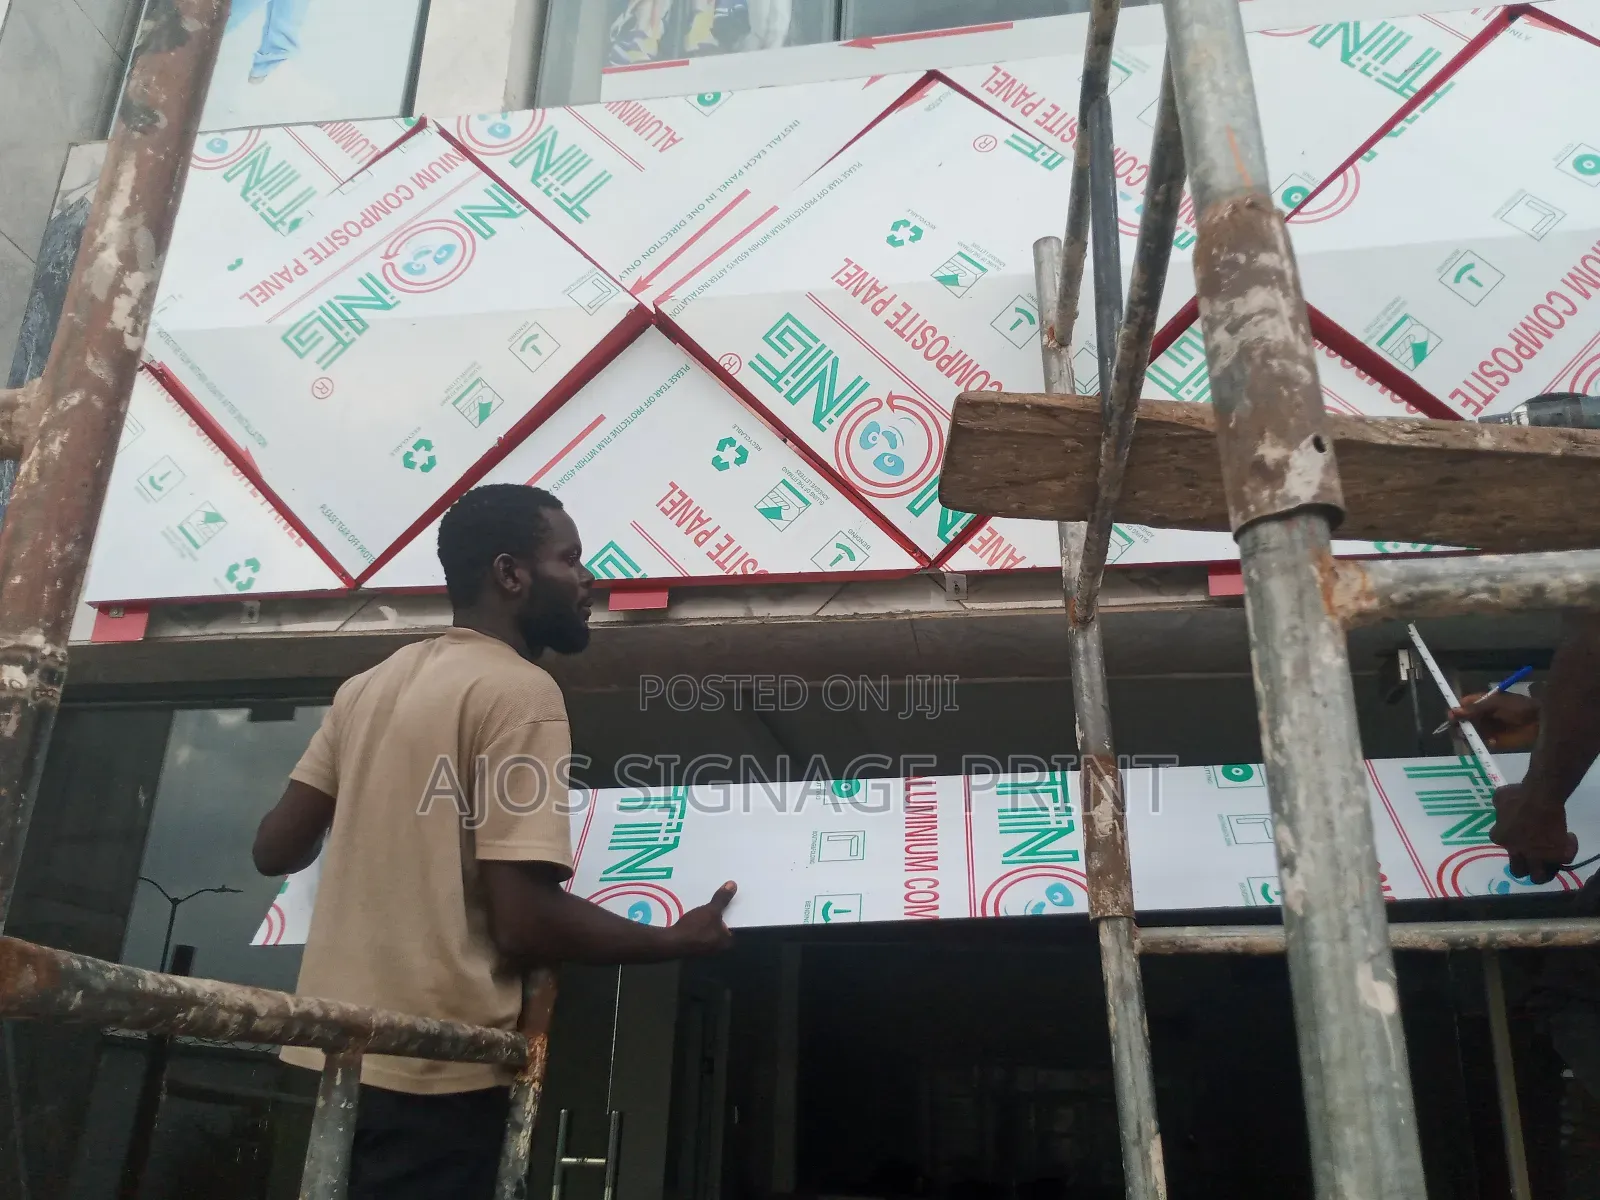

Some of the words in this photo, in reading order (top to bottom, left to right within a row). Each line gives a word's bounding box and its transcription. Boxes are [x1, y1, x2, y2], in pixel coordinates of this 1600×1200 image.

[980, 64, 1046, 117] PANEL
[764, 118, 801, 151] INSTALL
[742, 147, 767, 170] EACH
[715, 168, 744, 195] PANEL
[704, 191, 717, 204] IN
[685, 201, 706, 221] ONE
[303, 184, 415, 266] COMPOSITE
[640, 218, 687, 260] DIRECTION
[239, 258, 309, 308] PANEL
[619, 259, 643, 282] ONLY
[830, 257, 898, 316] PANEL
[1448, 290, 1578, 417] COMPOSITE
[667, 362, 691, 385] PLEASE
[641, 394, 656, 409] OFF
[652, 381, 670, 398] TEAR
[608, 404, 645, 439] PROTECTIVE
[595, 434, 612, 451] FILM
[730, 423, 763, 452] RECYCLABLE
[573, 446, 599, 471] WITHIN
[551, 466, 577, 491] 45DAYS
[656, 480, 721, 549] PANEL
[1204, 765, 1213, 785] UTTING
